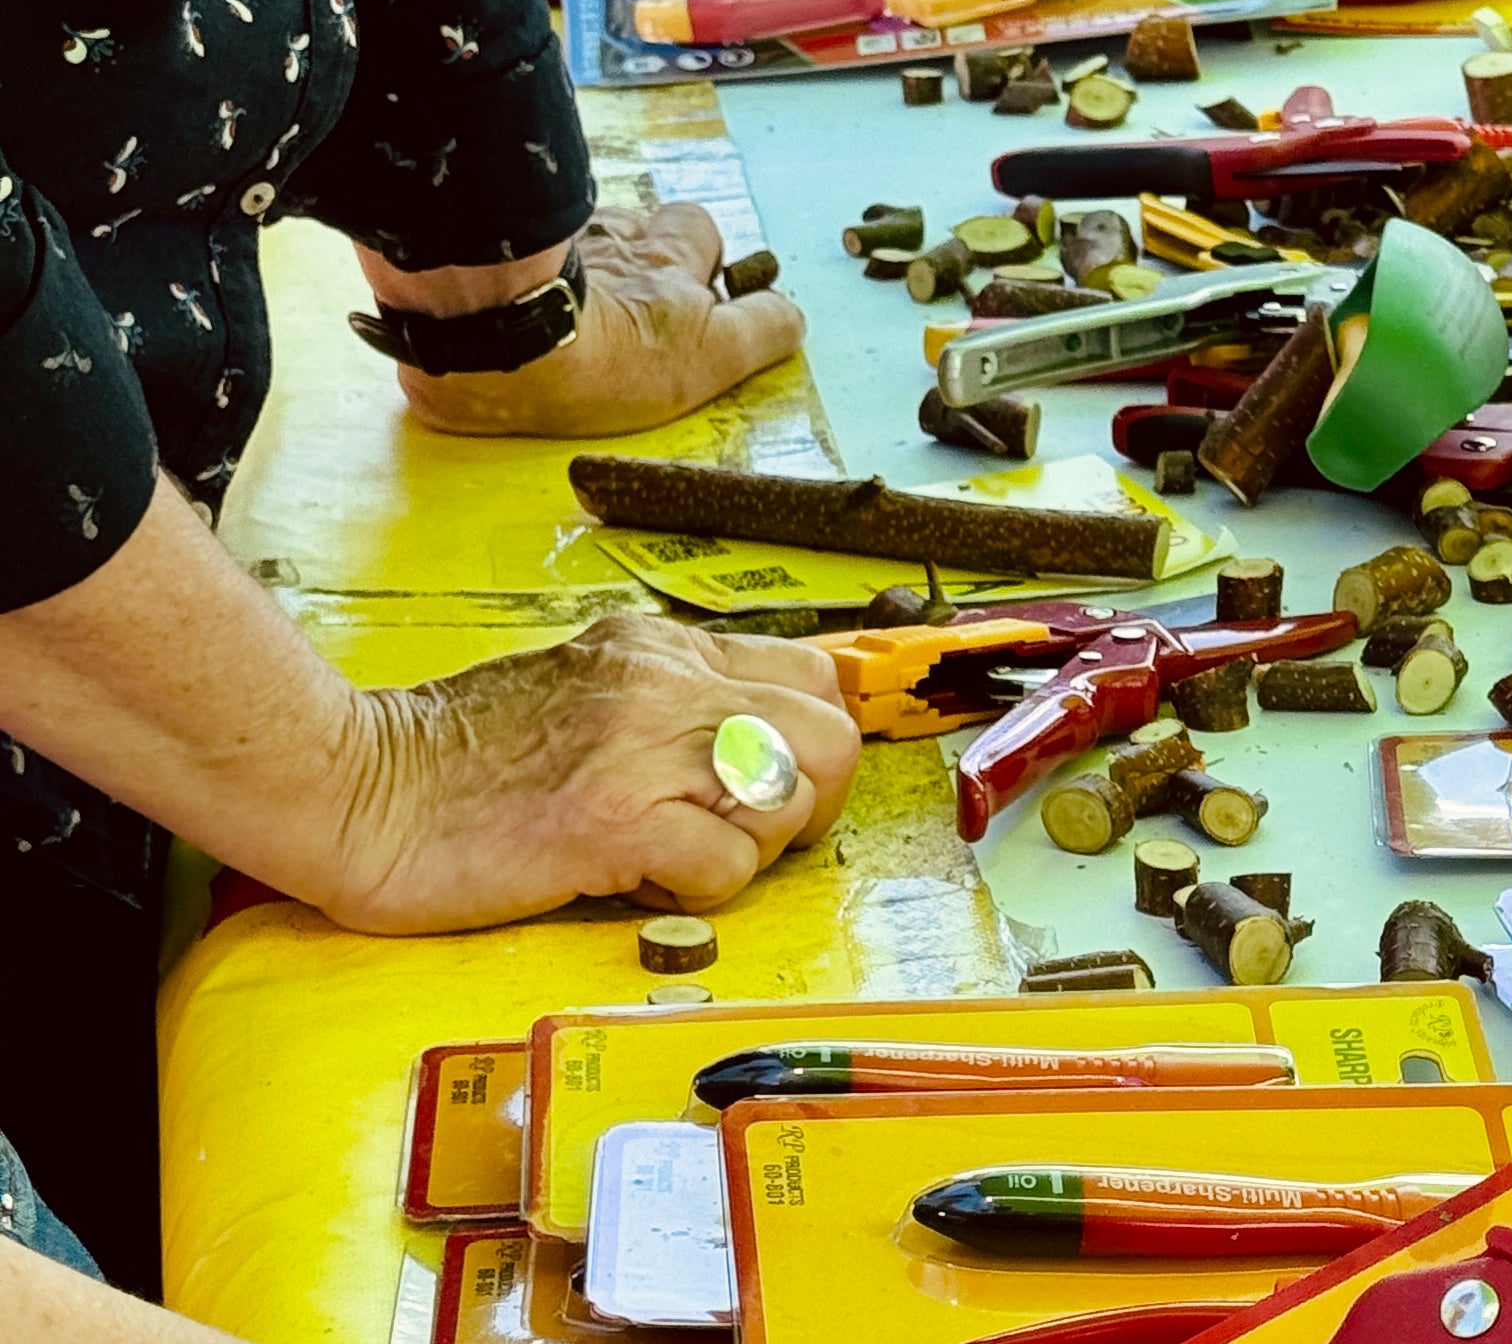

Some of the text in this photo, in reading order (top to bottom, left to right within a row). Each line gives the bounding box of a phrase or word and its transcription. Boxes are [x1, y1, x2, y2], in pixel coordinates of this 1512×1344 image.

[784, 1155, 805, 1206] PRODUCTS
[1007, 1174, 1303, 1210] Multi-Sharpener Oil
